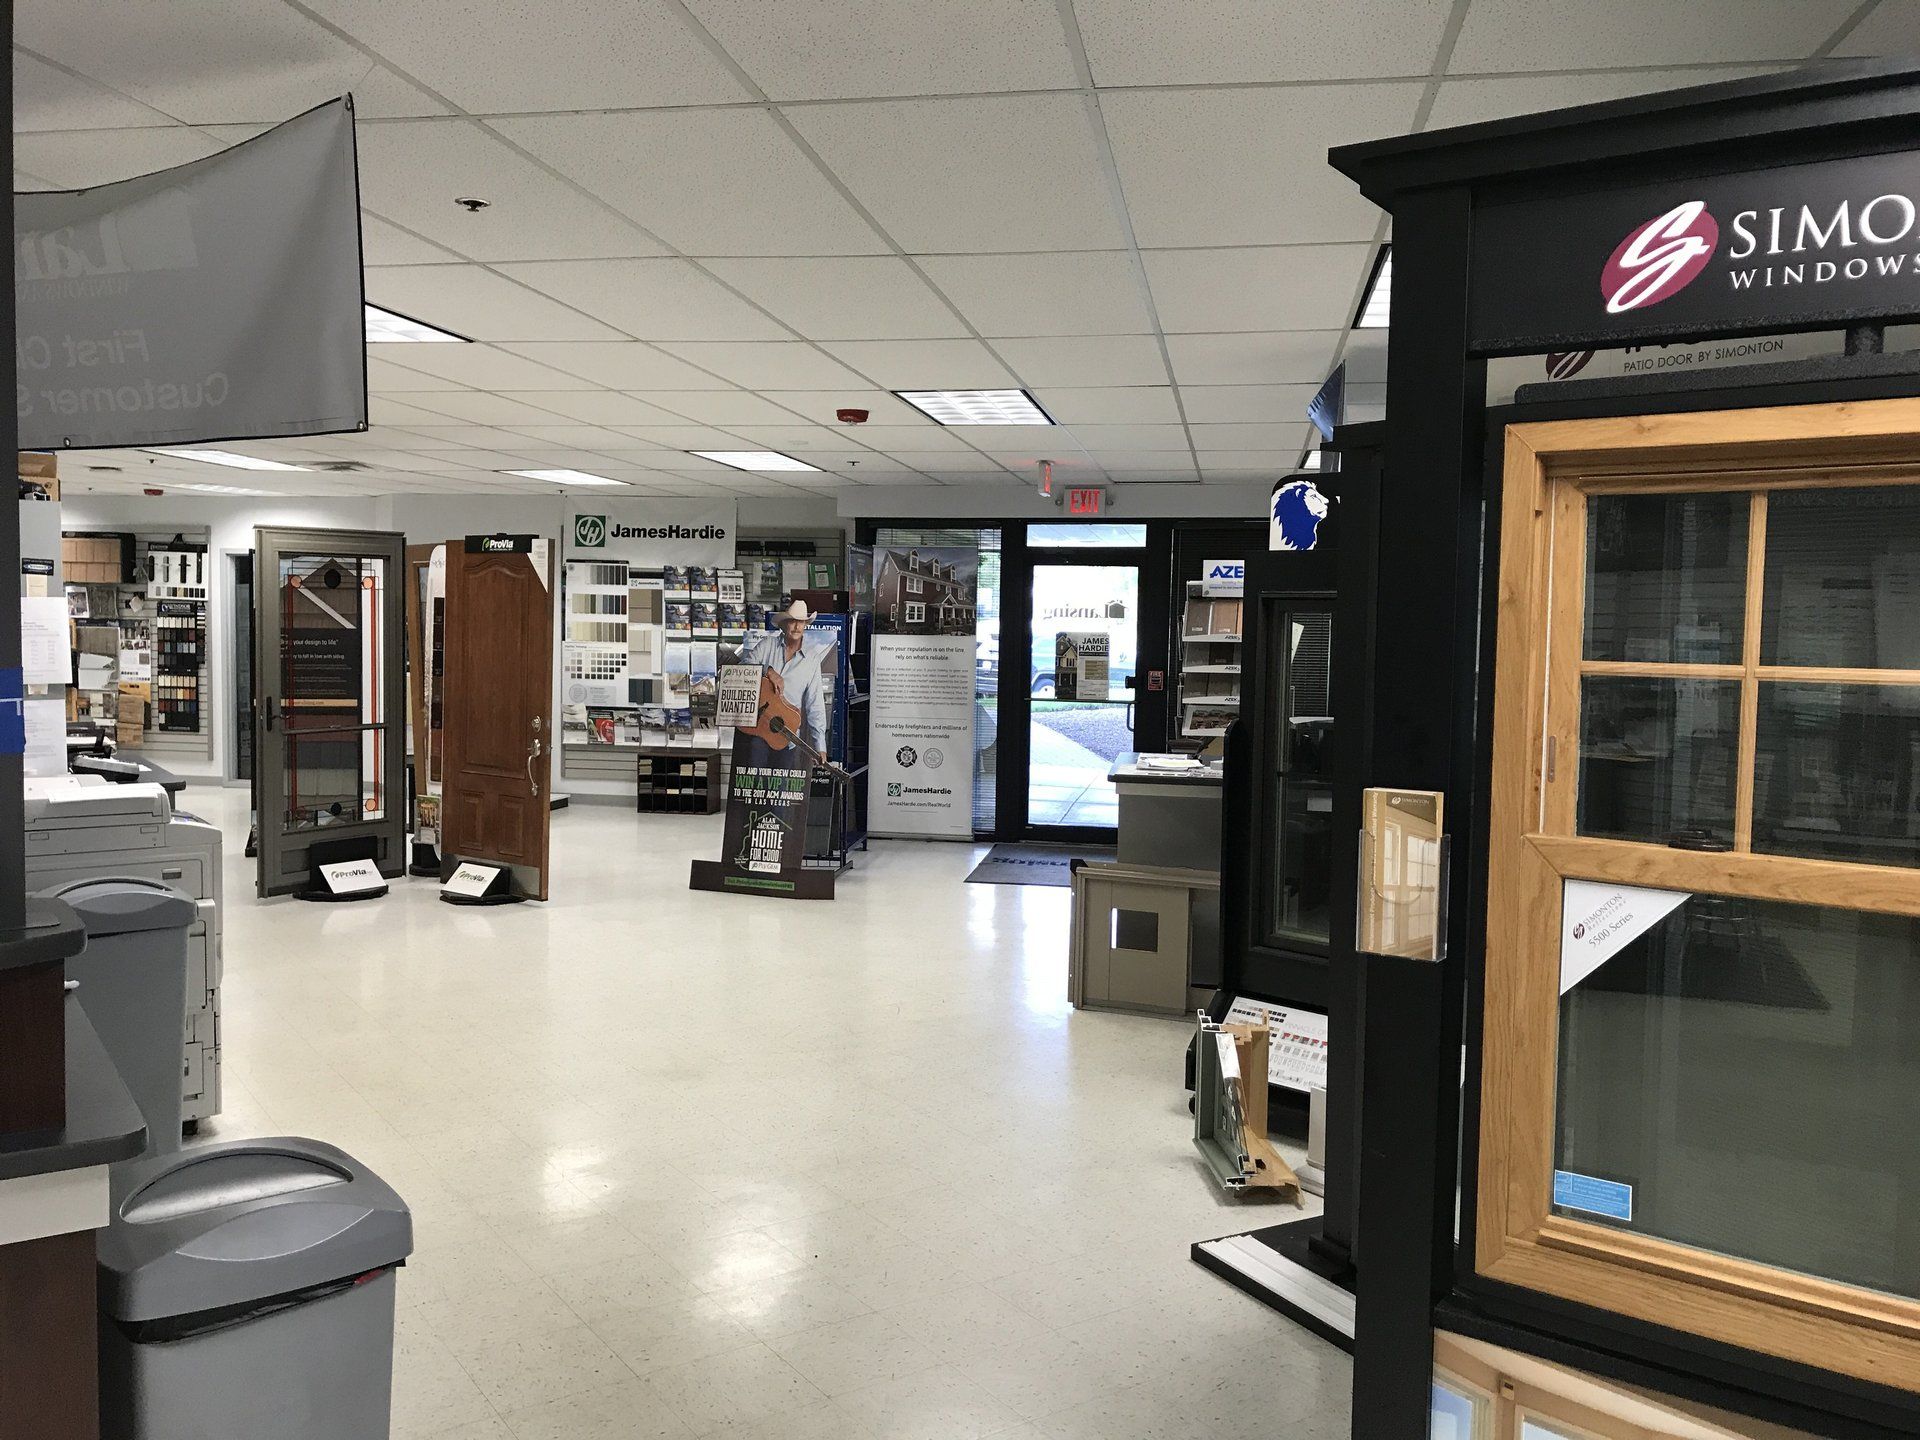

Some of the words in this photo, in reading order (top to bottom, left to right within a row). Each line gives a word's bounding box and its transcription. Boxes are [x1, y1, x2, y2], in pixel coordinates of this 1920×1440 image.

[1729, 252, 1920, 290] WINDOWS
[1623, 357, 1655, 374] PATIO
[1657, 352, 1694, 370] DOOR
[1697, 349, 1713, 364] BY
[1715, 339, 1784, 361] SIMONTON
[1071, 489, 1101, 513] EXIT
[611, 523, 726, 540] JamesHardie
[490, 539, 514, 549] ProVia
[1209, 565, 1244, 579] AZE
[1082, 637, 1110, 645] JAMES
[1079, 644, 1110, 652] HARDIE
[743, 668, 758, 677] GEM
[721, 689, 757, 701] BUILDERS
[721, 700, 756, 714] WANTED
[736, 766, 747, 775] YOU
[747, 767, 758, 776] AND
[758, 767, 773, 776] YOUR
[772, 768, 789, 778] CREW
[789, 769, 807, 779] COULD
[735, 774, 755, 788] WIN
[757, 775, 764, 790] A
[767, 776, 782, 790] VIP
[785, 777, 806, 792] TRIP
[734, 788, 741, 797] TO
[741, 788, 753, 797] THE
[752, 789, 766, 798] 2017
[766, 790, 780, 800] ACM
[780, 791, 805, 801] AWARDS
[902, 786, 952, 795] JamesHardie
[754, 798, 767, 806] LAS
[769, 799, 791, 807] VEGAS
[887, 800, 952, 808] JamesHardie.com/RealWorld
[756, 822, 781, 831] JACKSON
[750, 829, 785, 850] HOME
[749, 847, 762, 861] FOR
[762, 849, 780, 863] GOOD
[339, 869, 367, 878] ProVia
[463, 873, 485, 883] ProVia
[1582, 892, 1624, 927] SIMONTON
[1588, 928, 1612, 948] 5500
[1609, 912, 1635, 933] Series
